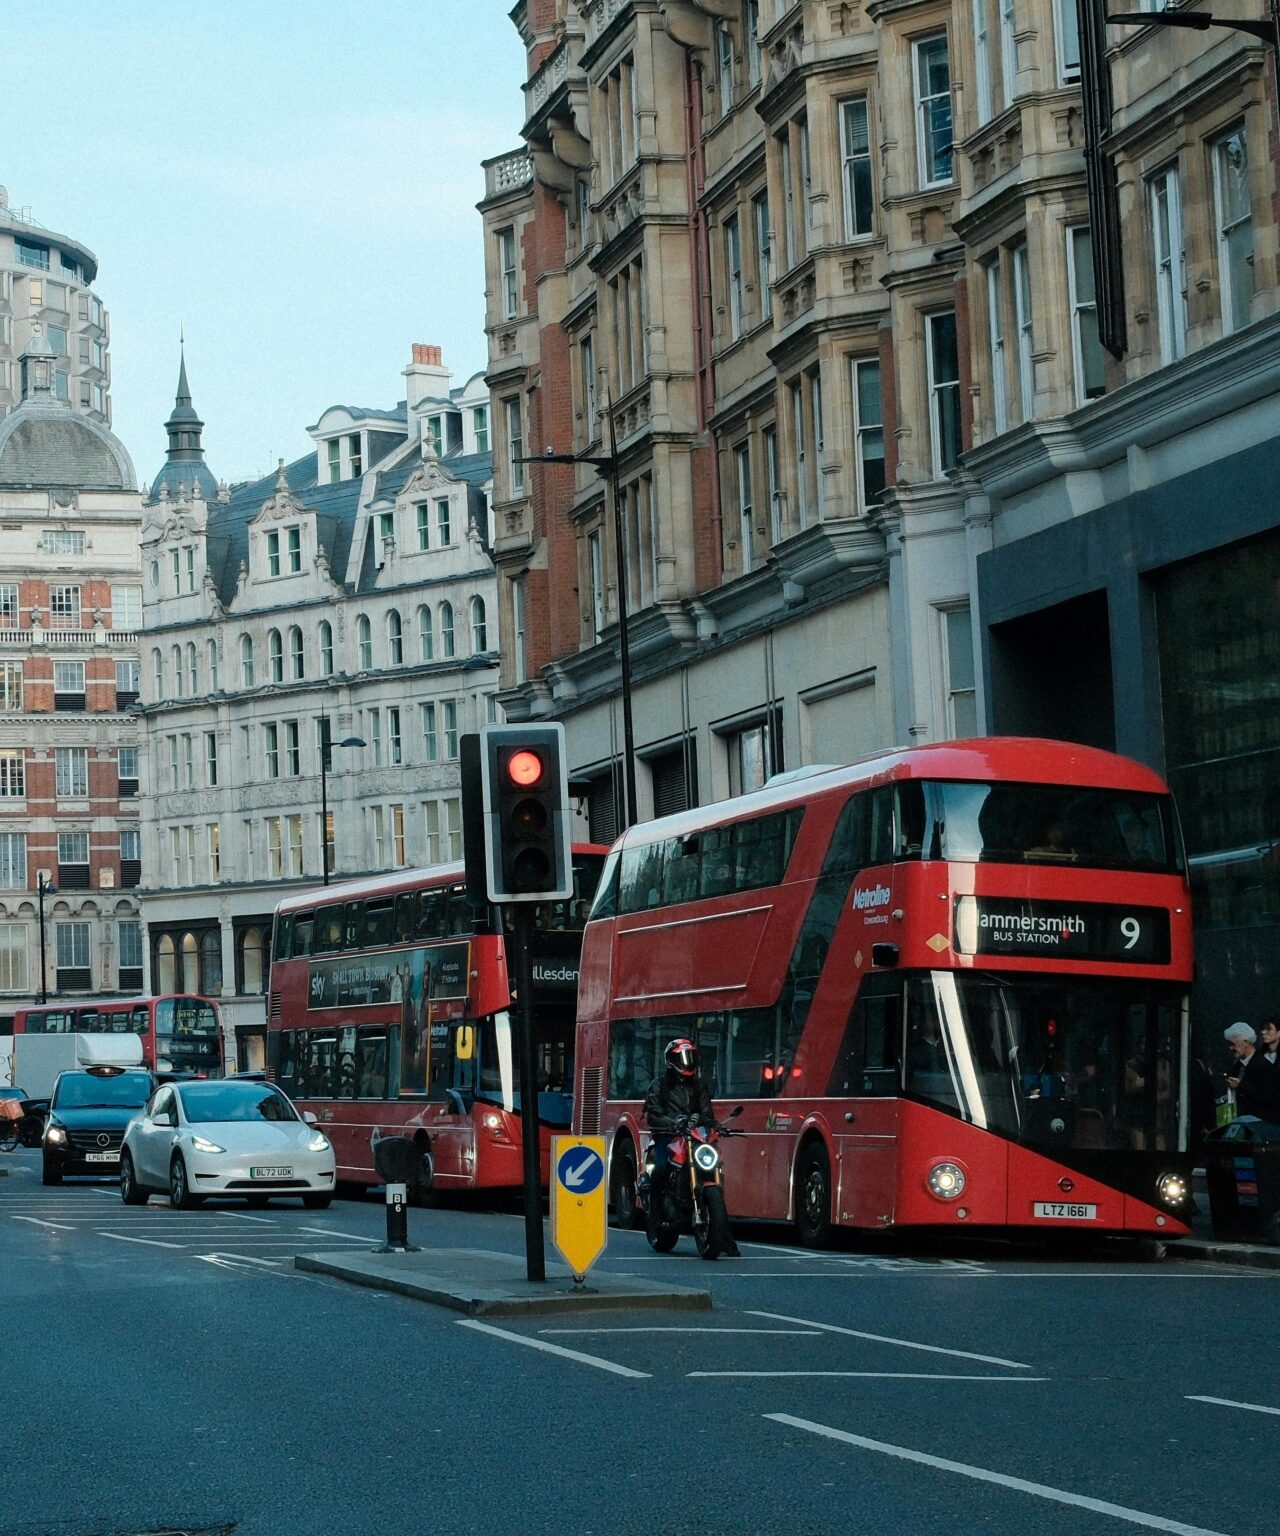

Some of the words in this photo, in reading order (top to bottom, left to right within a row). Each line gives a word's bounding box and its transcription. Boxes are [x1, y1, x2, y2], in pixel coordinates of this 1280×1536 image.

[852, 883, 891, 910] Metroline
[993, 931, 1013, 942] BUS
[1017, 932, 1059, 944] STATION
[1120, 917, 1140, 949] 9
[531, 965, 580, 981] illesden
[311, 971, 325, 1000] sky
[198, 1043, 209, 1054] 14
[256, 1168, 276, 1177] BL72
[394, 1194, 401, 1203] B
[395, 1204, 401, 1213] 6
[1043, 1204, 1065, 1217] LTZ
[1067, 1205, 1088, 1217] 1661
